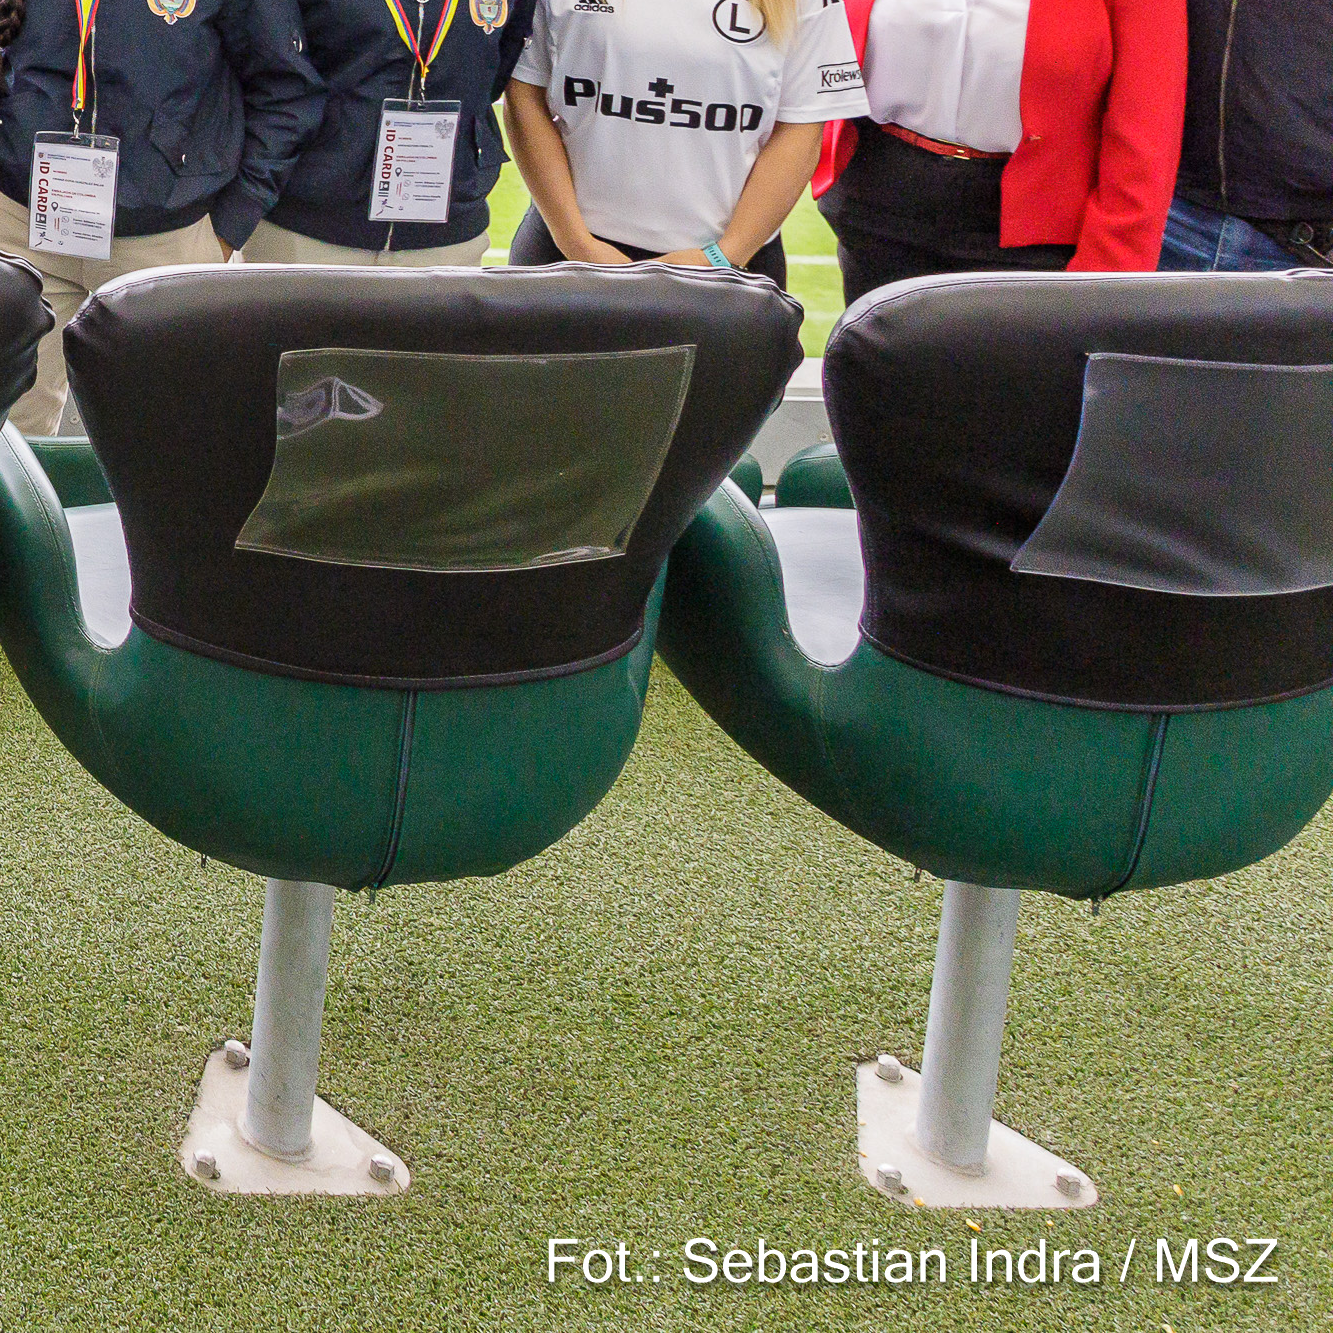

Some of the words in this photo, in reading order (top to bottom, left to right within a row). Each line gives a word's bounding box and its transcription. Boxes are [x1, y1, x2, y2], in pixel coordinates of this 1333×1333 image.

[574, 3, 614, 13] adidas
[729, 3, 751, 35] L
[385, 129, 396, 142] ID
[39, 161, 50, 175] ID
[381, 145, 394, 180] CARD
[37, 178, 49, 213] CARD
